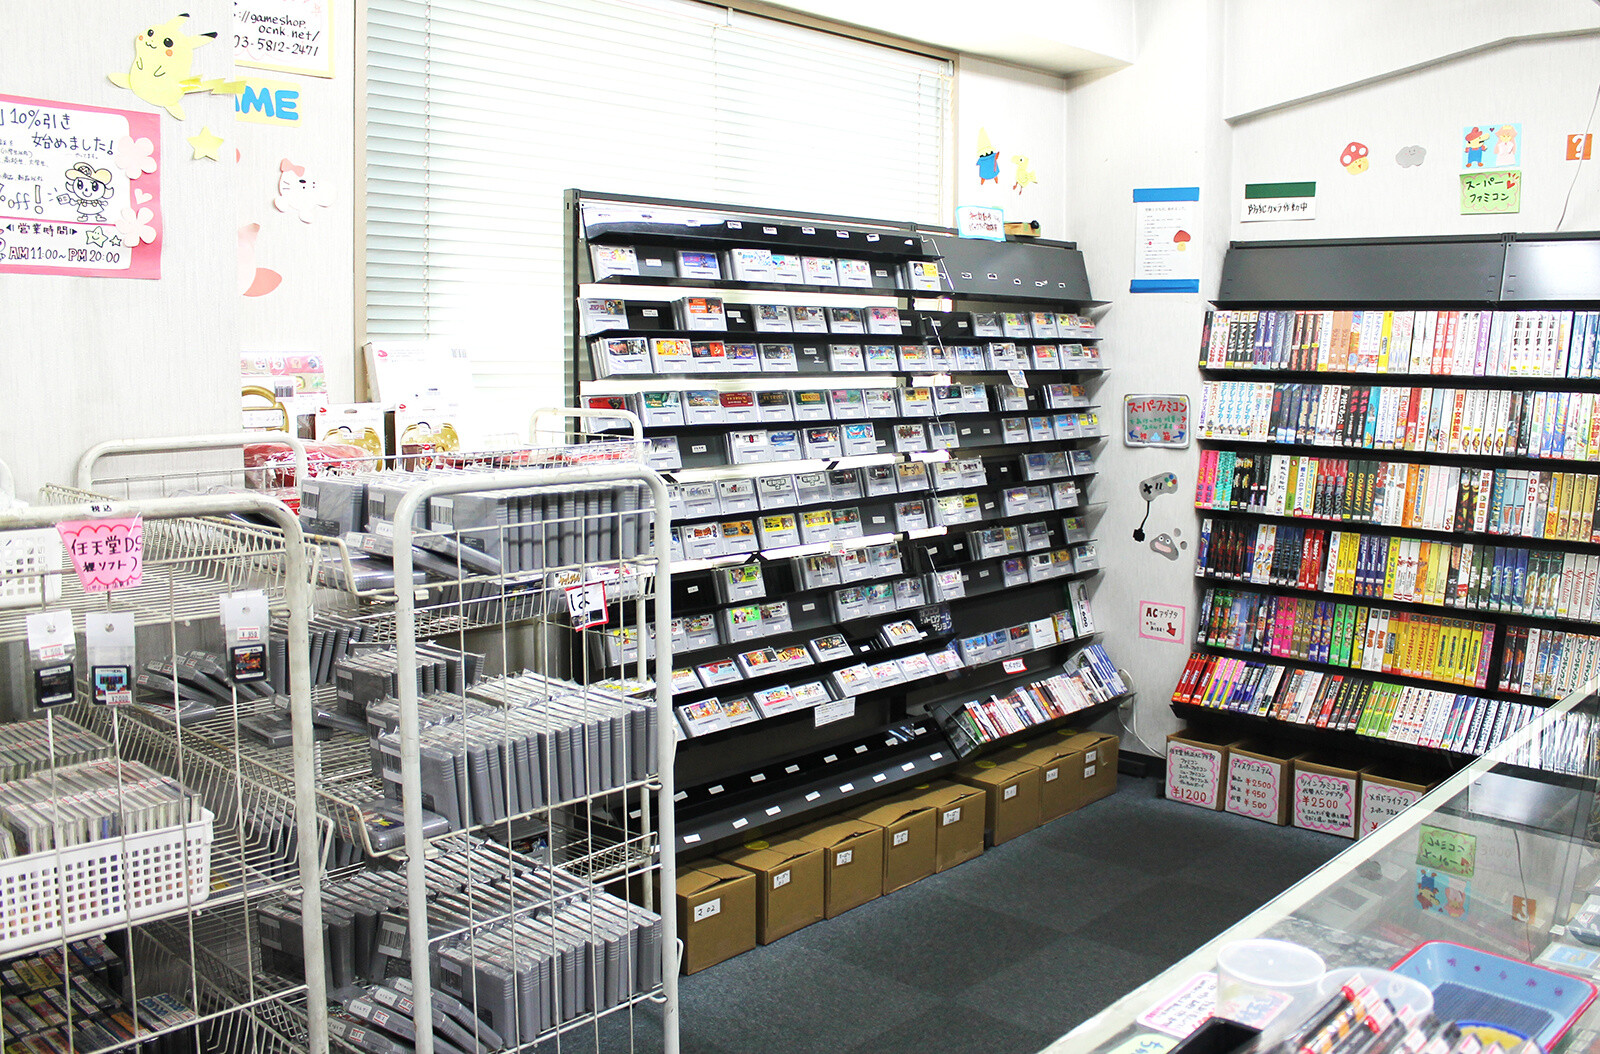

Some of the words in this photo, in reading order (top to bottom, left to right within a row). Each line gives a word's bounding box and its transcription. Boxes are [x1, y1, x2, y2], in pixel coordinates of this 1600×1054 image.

[1465, 176, 1504, 191] スーパー
[1469, 192, 1509, 204] ファミコン
[1128, 399, 1188, 414] スーパーファミコン
[1173, 785, 1207, 803] ¥1200
[1302, 795, 1339, 810] ¥2500
